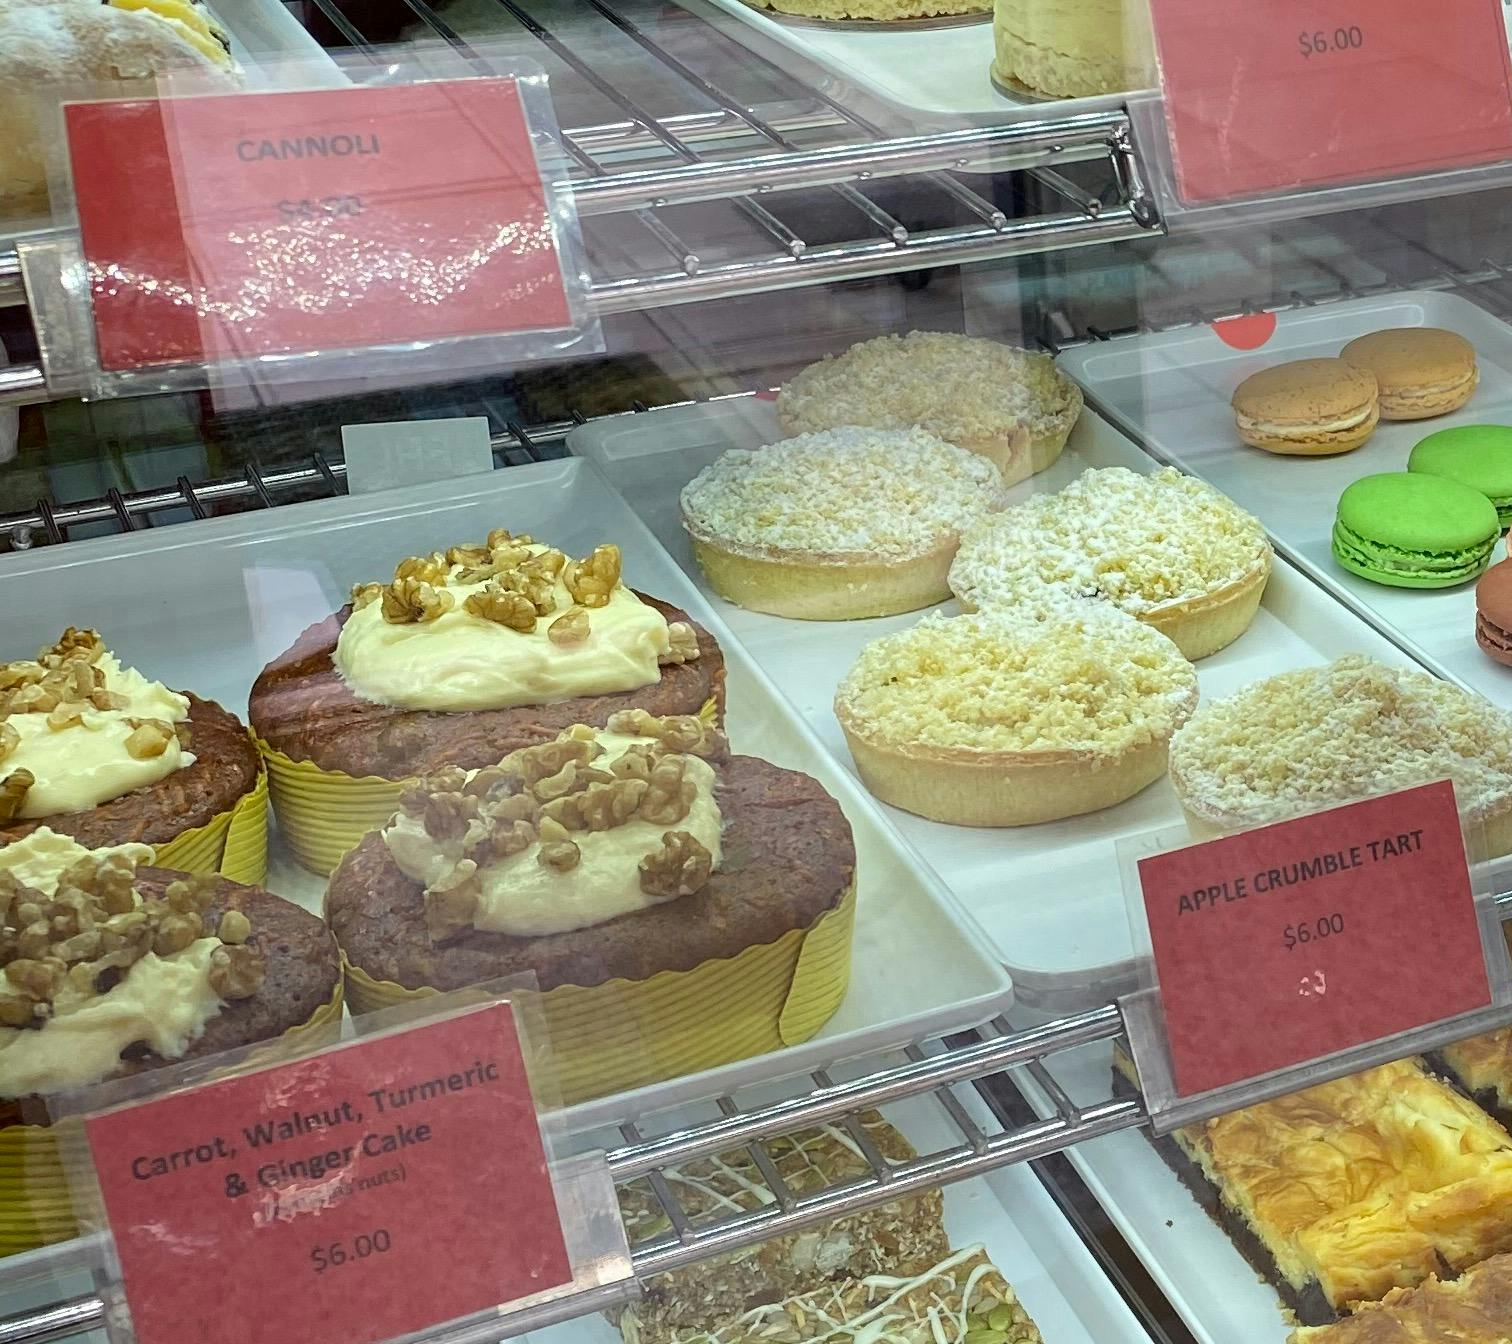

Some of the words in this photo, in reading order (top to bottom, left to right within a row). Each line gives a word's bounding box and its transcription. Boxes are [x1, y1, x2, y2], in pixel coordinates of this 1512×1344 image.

[1298, 25, 1363, 58] $6.00
[236, 134, 381, 162] CANNOLI
[1178, 877, 1248, 916] APPLE
[1253, 846, 1364, 894] CRUMBLE
[1366, 829, 1424, 862] TART
[1283, 912, 1344, 950] $6.00
[131, 1135, 238, 1181] Carrot,
[242, 1099, 364, 1148] Walnut,
[368, 1061, 500, 1113] Turmeric
[223, 1171, 249, 1198] &
[257, 1147, 356, 1189] Ginger
[362, 1121, 433, 1157] Cake
[357, 1162, 407, 1193] nuts)
[310, 1228, 391, 1274] $6.00
